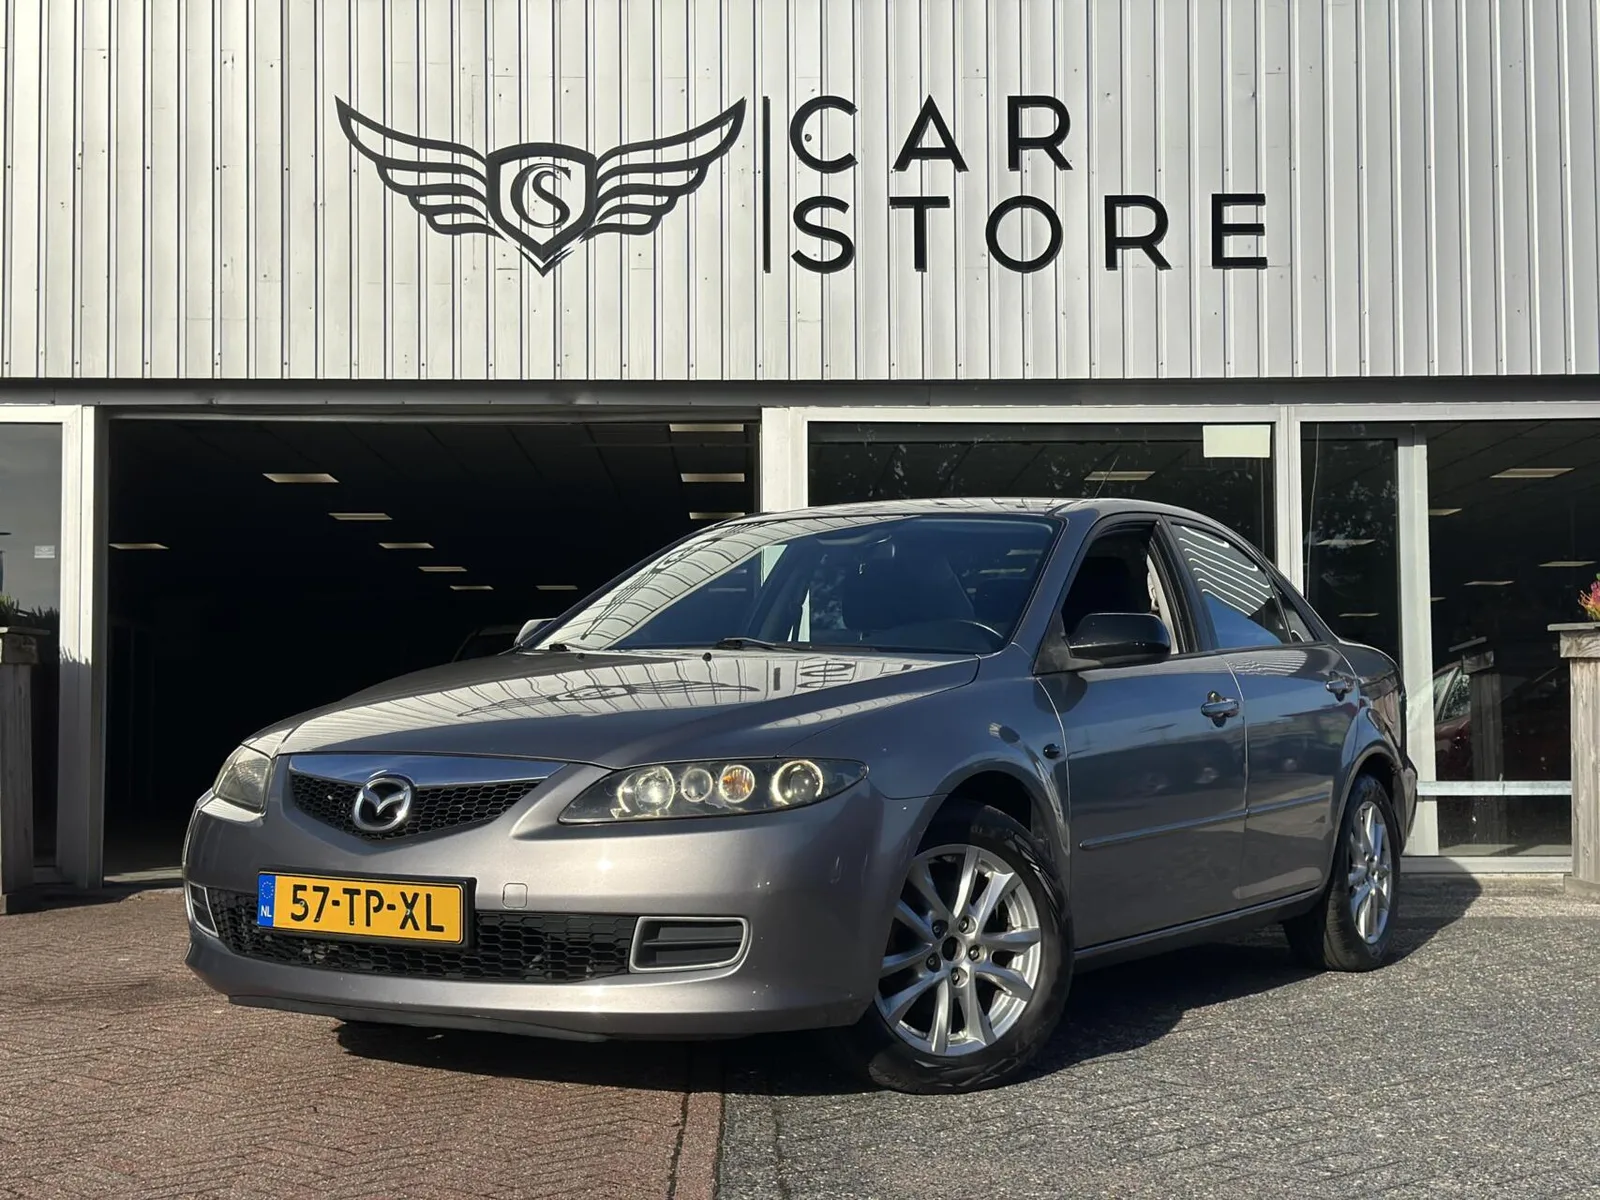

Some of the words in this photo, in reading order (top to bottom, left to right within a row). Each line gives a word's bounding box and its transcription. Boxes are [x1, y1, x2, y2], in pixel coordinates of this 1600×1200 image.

[790, 94, 1073, 173] CAR
[791, 193, 1268, 273] STORE
[260, 905, 273, 918] NL
[290, 884, 445, 933] 57-TP-XL
